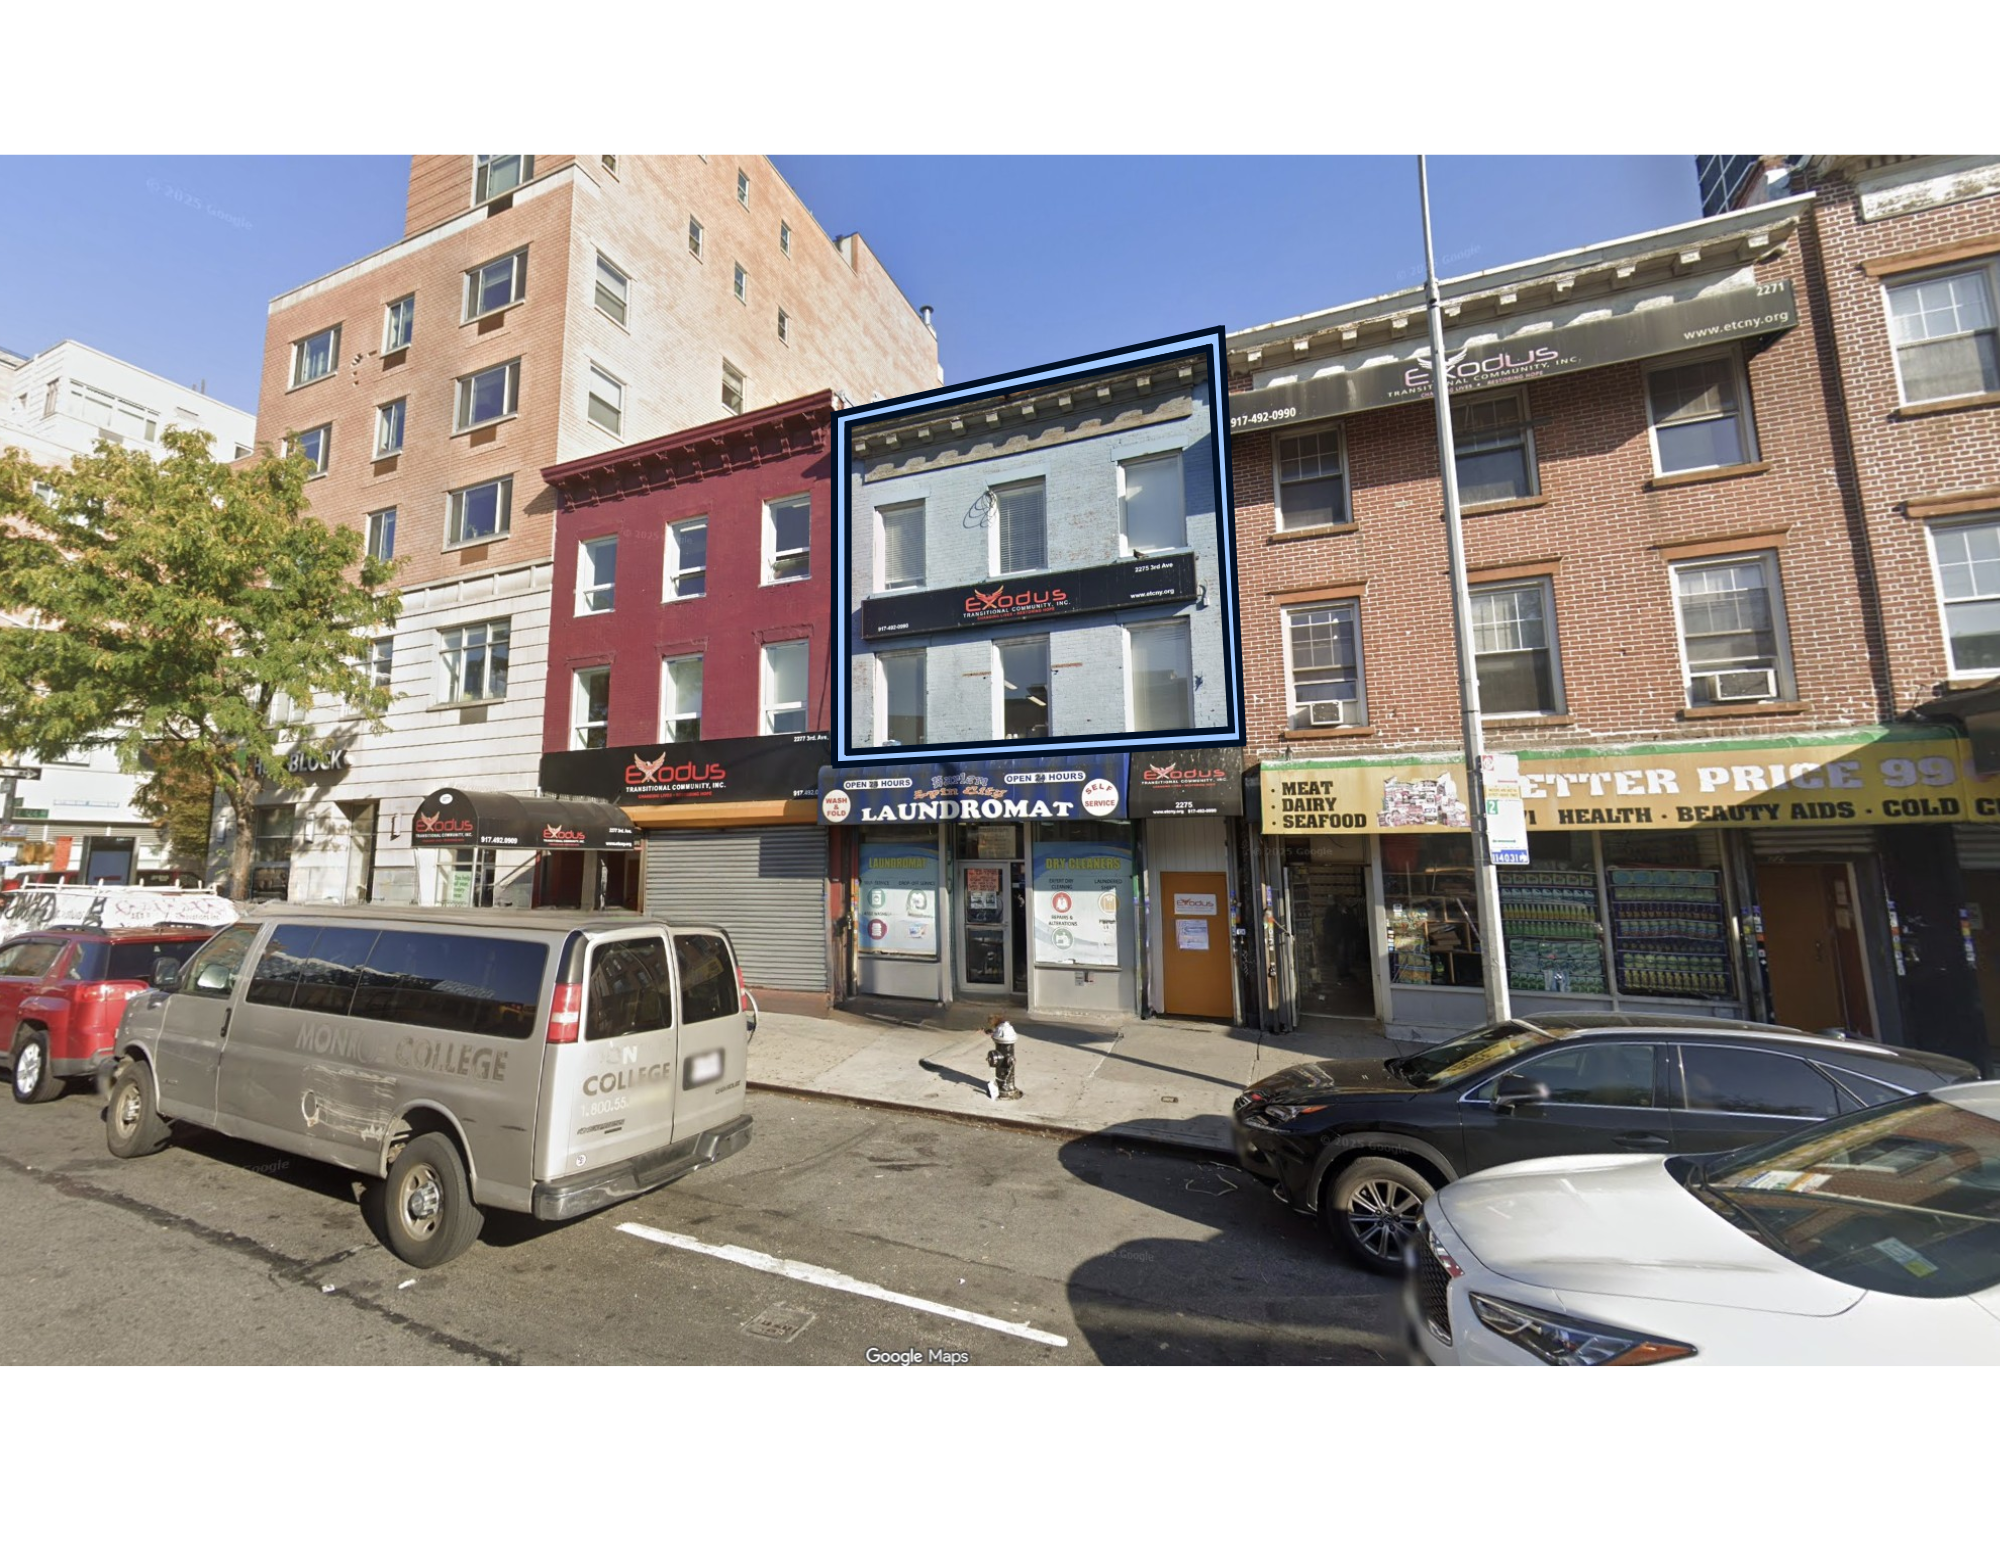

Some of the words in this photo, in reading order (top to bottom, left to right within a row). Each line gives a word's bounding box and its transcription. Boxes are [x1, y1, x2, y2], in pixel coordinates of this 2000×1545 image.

[1756, 282, 1785, 297] 2271
[1683, 311, 1789, 341] www.etcny.org
[1387, 379, 1470, 398] TRANSITNAL
[1473, 361, 1551, 382] COMMUNITY,
[1555, 355, 1582, 367] INC.
[1455, 384, 1474, 394] LIVES
[1525, 369, 1545, 379] HOPE
[1230, 407, 1297, 428] 917-492-0990
[1134, 564, 1150, 573] 2275
[965, 584, 1068, 612] Exodus
[1129, 588, 1175, 599] www.etcny.org
[963, 607, 1010, 619] TRANSITIONAL
[1011, 601, 1054, 613] COMMUNITY,
[1056, 599, 1072, 607] INC.
[793, 735, 806, 743] 2277
[288, 748, 344, 773] BLOCK
[625, 751, 727, 784] Exodus
[1006, 774, 1032, 783] OPEN
[1048, 772, 1084, 781] HOURS
[1143, 762, 1226, 780] Exodus
[1519, 767, 1680, 800] ETTER
[1697, 760, 1864, 793] PRICE
[1879, 755, 1957, 788] 99
[626, 785, 671, 793] TRANSITIONAL
[671, 782, 712, 791] COMMUNITY,
[712, 781, 727, 789] INC.
[845, 781, 867, 789] OPEN
[881, 778, 911, 787] HOURS
[1085, 783, 1113, 795] SELF
[1281, 780, 1334, 796] MEAT
[861, 798, 1074, 822] LAUNDROMAT
[1084, 799, 1116, 808] SERVICE
[1175, 801, 1193, 809] 2275
[1281, 797, 1338, 812] DAIRY
[1557, 807, 1653, 826] HEALTH
[1675, 803, 1781, 823] BEAUTY
[1790, 800, 1857, 820] AIDS
[1881, 797, 1960, 817] COLD
[415, 811, 474, 833] Exodus
[1282, 813, 1368, 829] SEAFOOD
[543, 824, 586, 839] Exodus
[869, 857, 928, 869] LAUNDROMAT
[1045, 858, 1066, 870] DRY
[1067, 858, 1121, 870] CLEANERS
[394, 1034, 509, 1083] COLLEGE
[581, 1062, 671, 1097] COLLEGE
